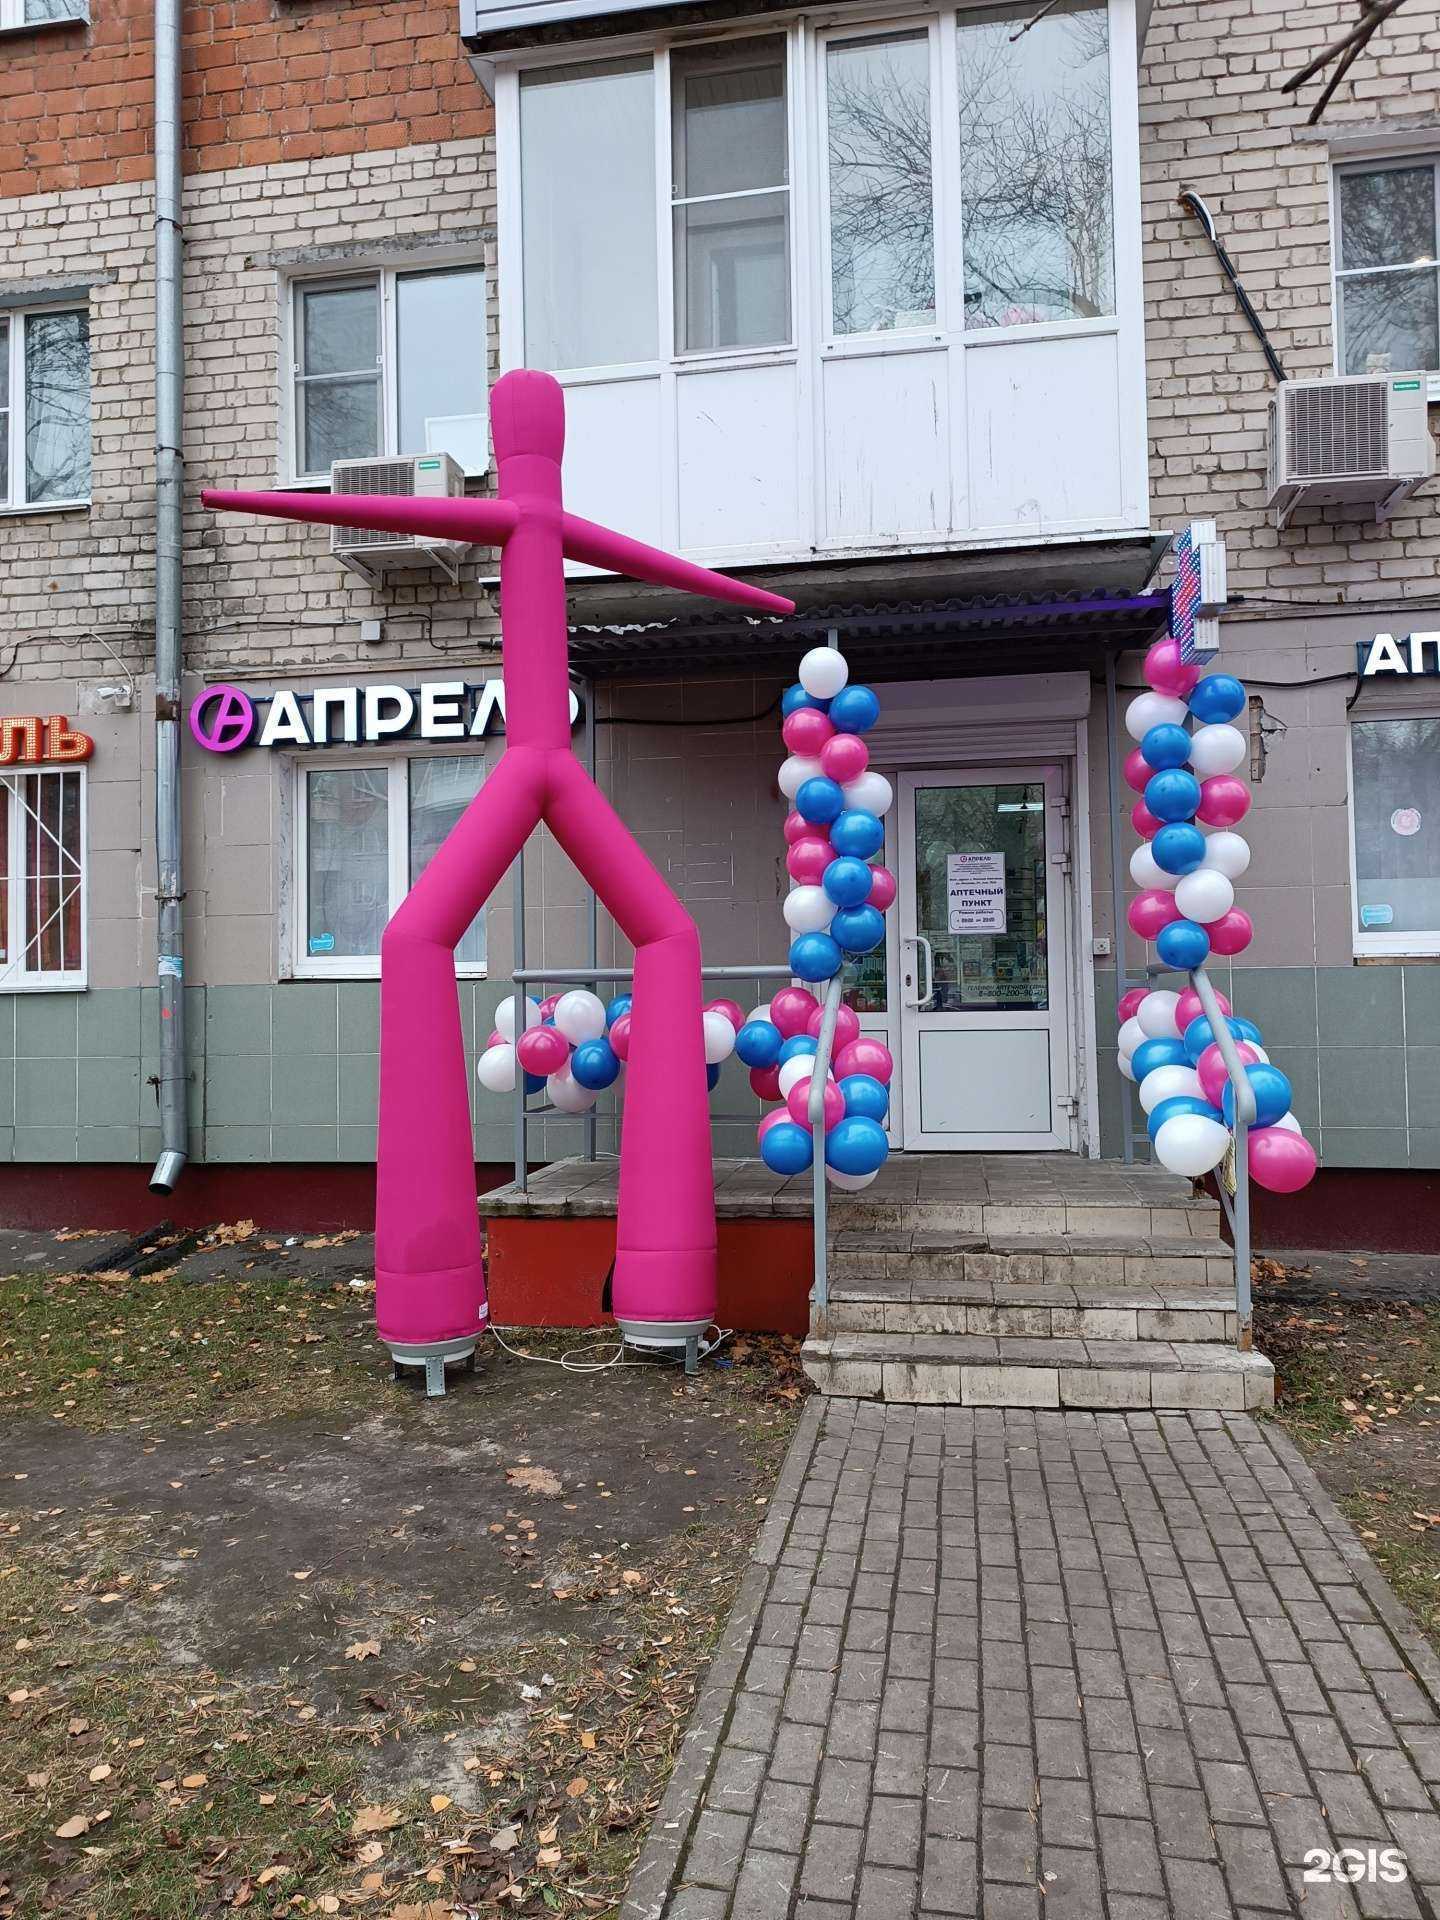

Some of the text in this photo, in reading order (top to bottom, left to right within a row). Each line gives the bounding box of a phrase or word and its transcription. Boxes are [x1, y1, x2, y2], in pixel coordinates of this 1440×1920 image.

[1363, 631, 1440, 675] АП
[259, 679, 579, 745] АПРЕЛ
[0, 715, 95, 763] ЛЬ
[950, 887, 1004, 896] АПТЕЧНЫЙ
[961, 899, 993, 907] ПУНКТ
